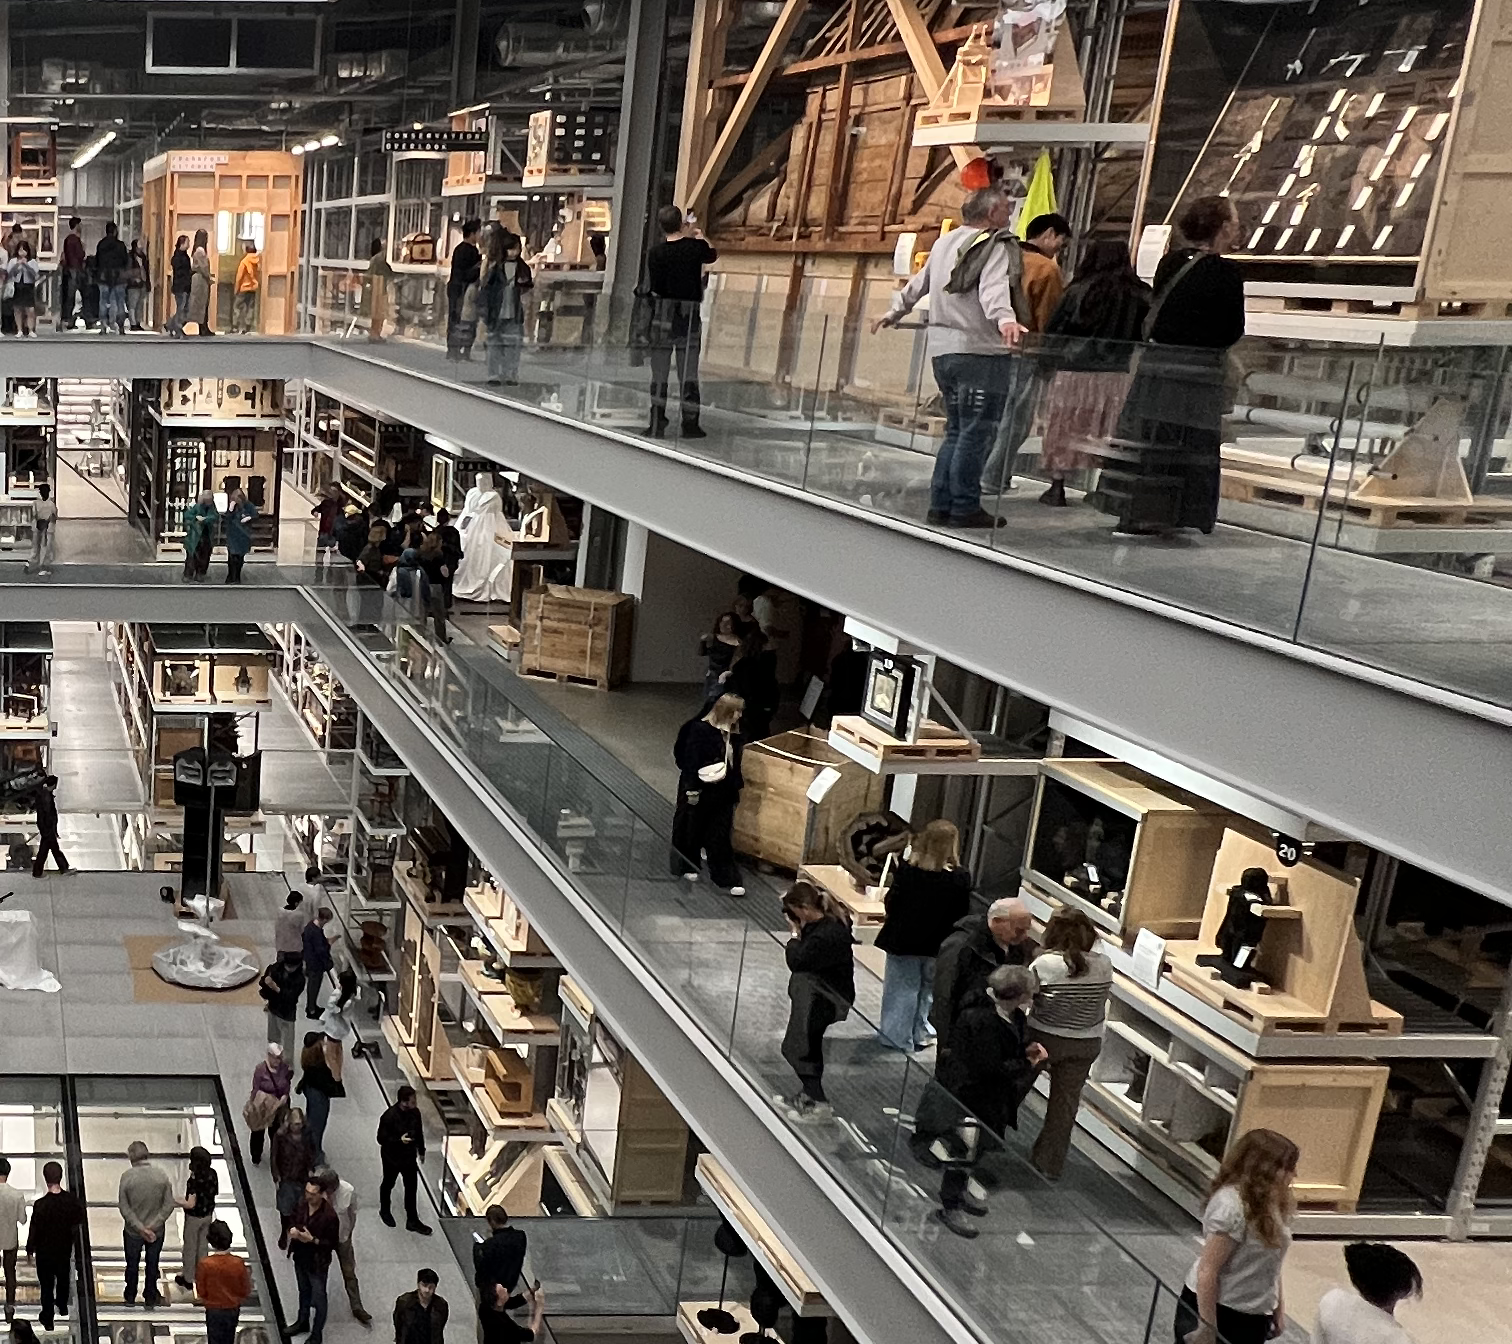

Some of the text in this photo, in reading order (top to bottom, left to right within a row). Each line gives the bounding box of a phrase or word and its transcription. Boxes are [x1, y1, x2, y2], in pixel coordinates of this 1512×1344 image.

[385, 131, 480, 141] CONSERVATION
[385, 142, 448, 151] OVERLOOK
[1278, 843, 1297, 861] 20
